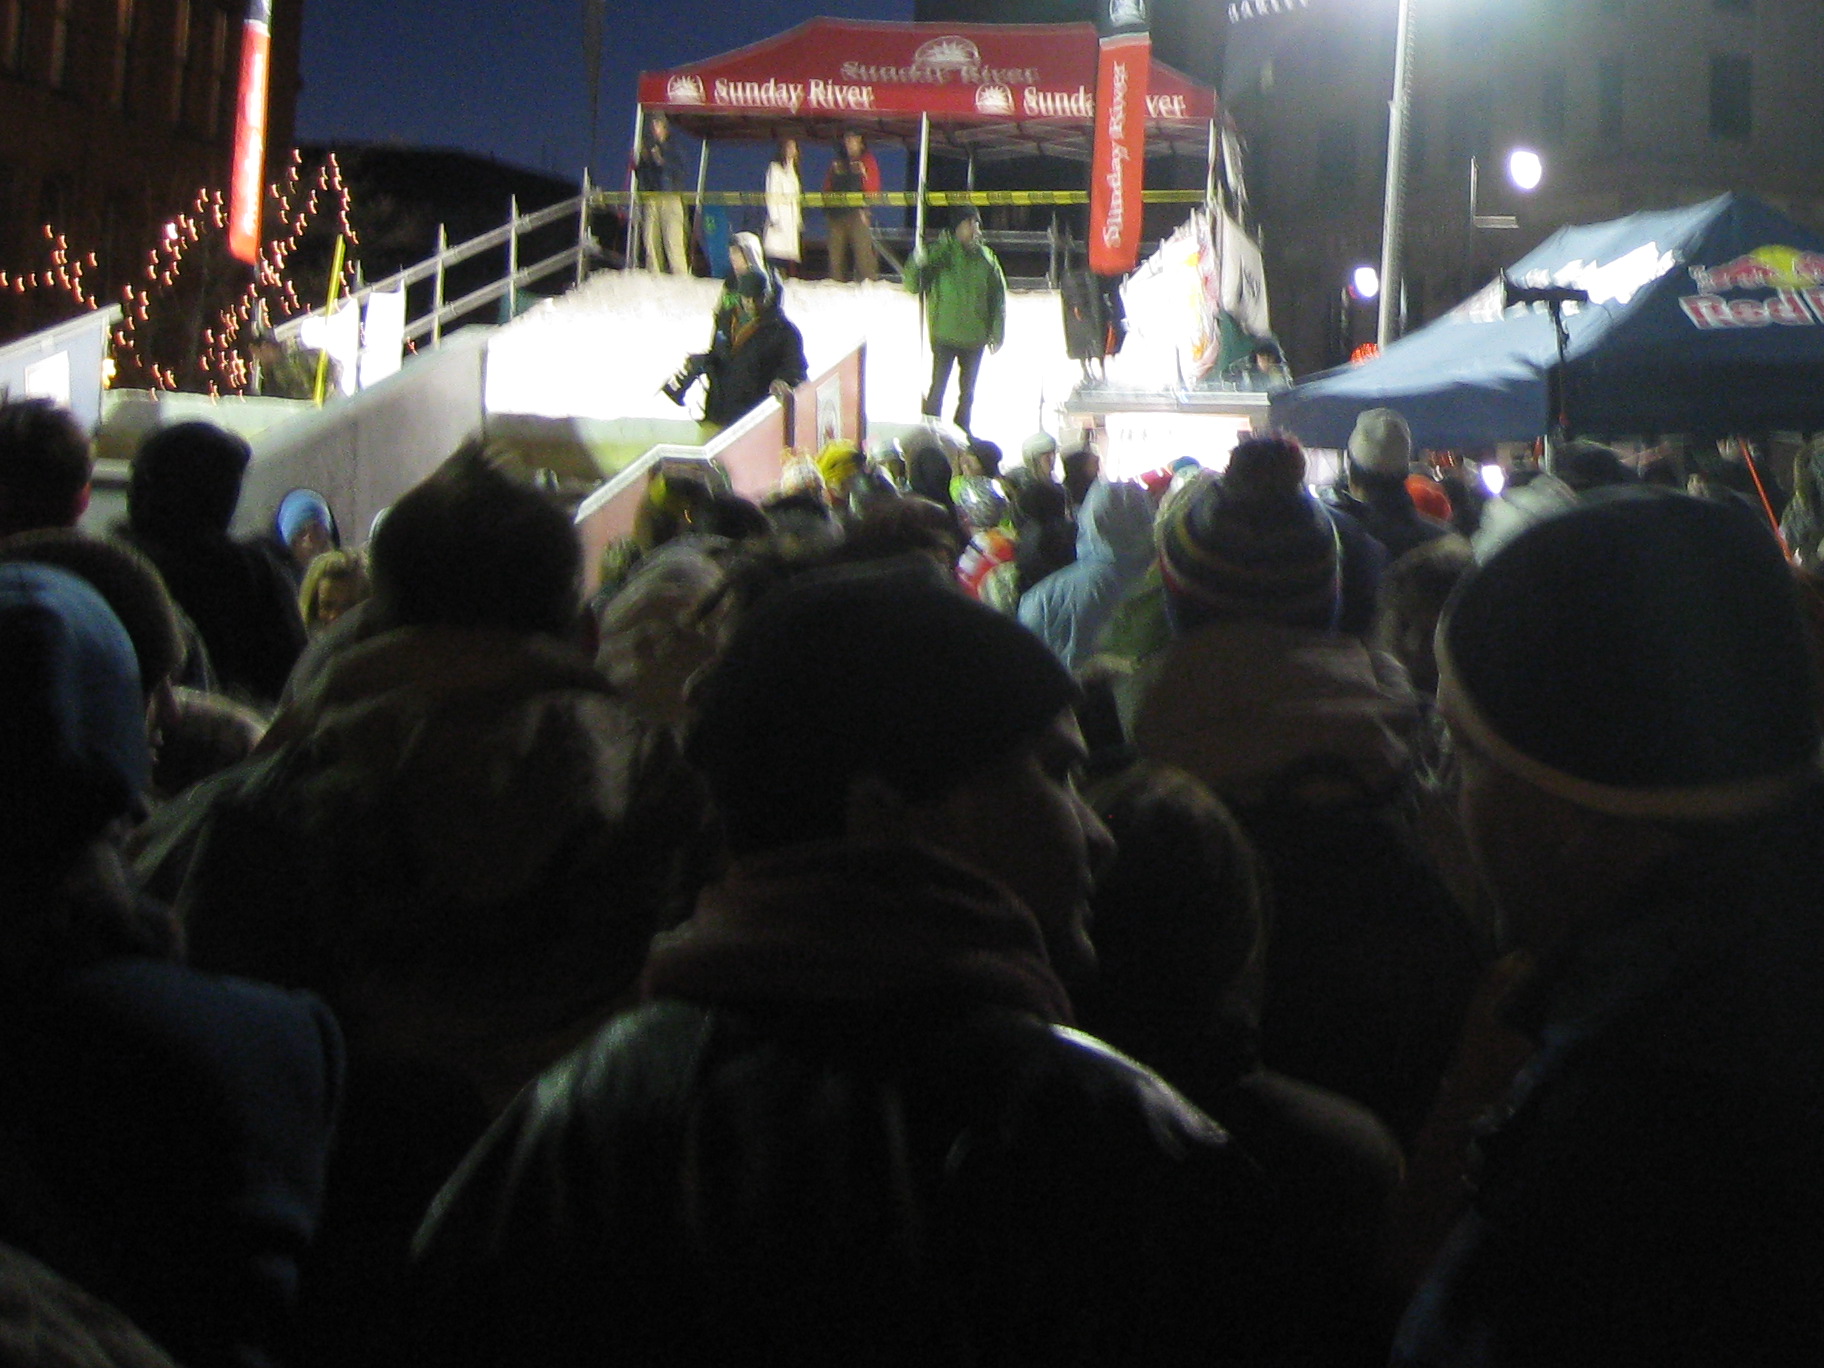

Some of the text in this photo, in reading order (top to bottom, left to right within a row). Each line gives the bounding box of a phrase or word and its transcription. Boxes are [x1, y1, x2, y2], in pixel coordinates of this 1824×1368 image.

[714, 77, 874, 115] Sunday River
[1023, 85, 1186, 118] Sunda ver
[1678, 286, 1816, 330] Red
